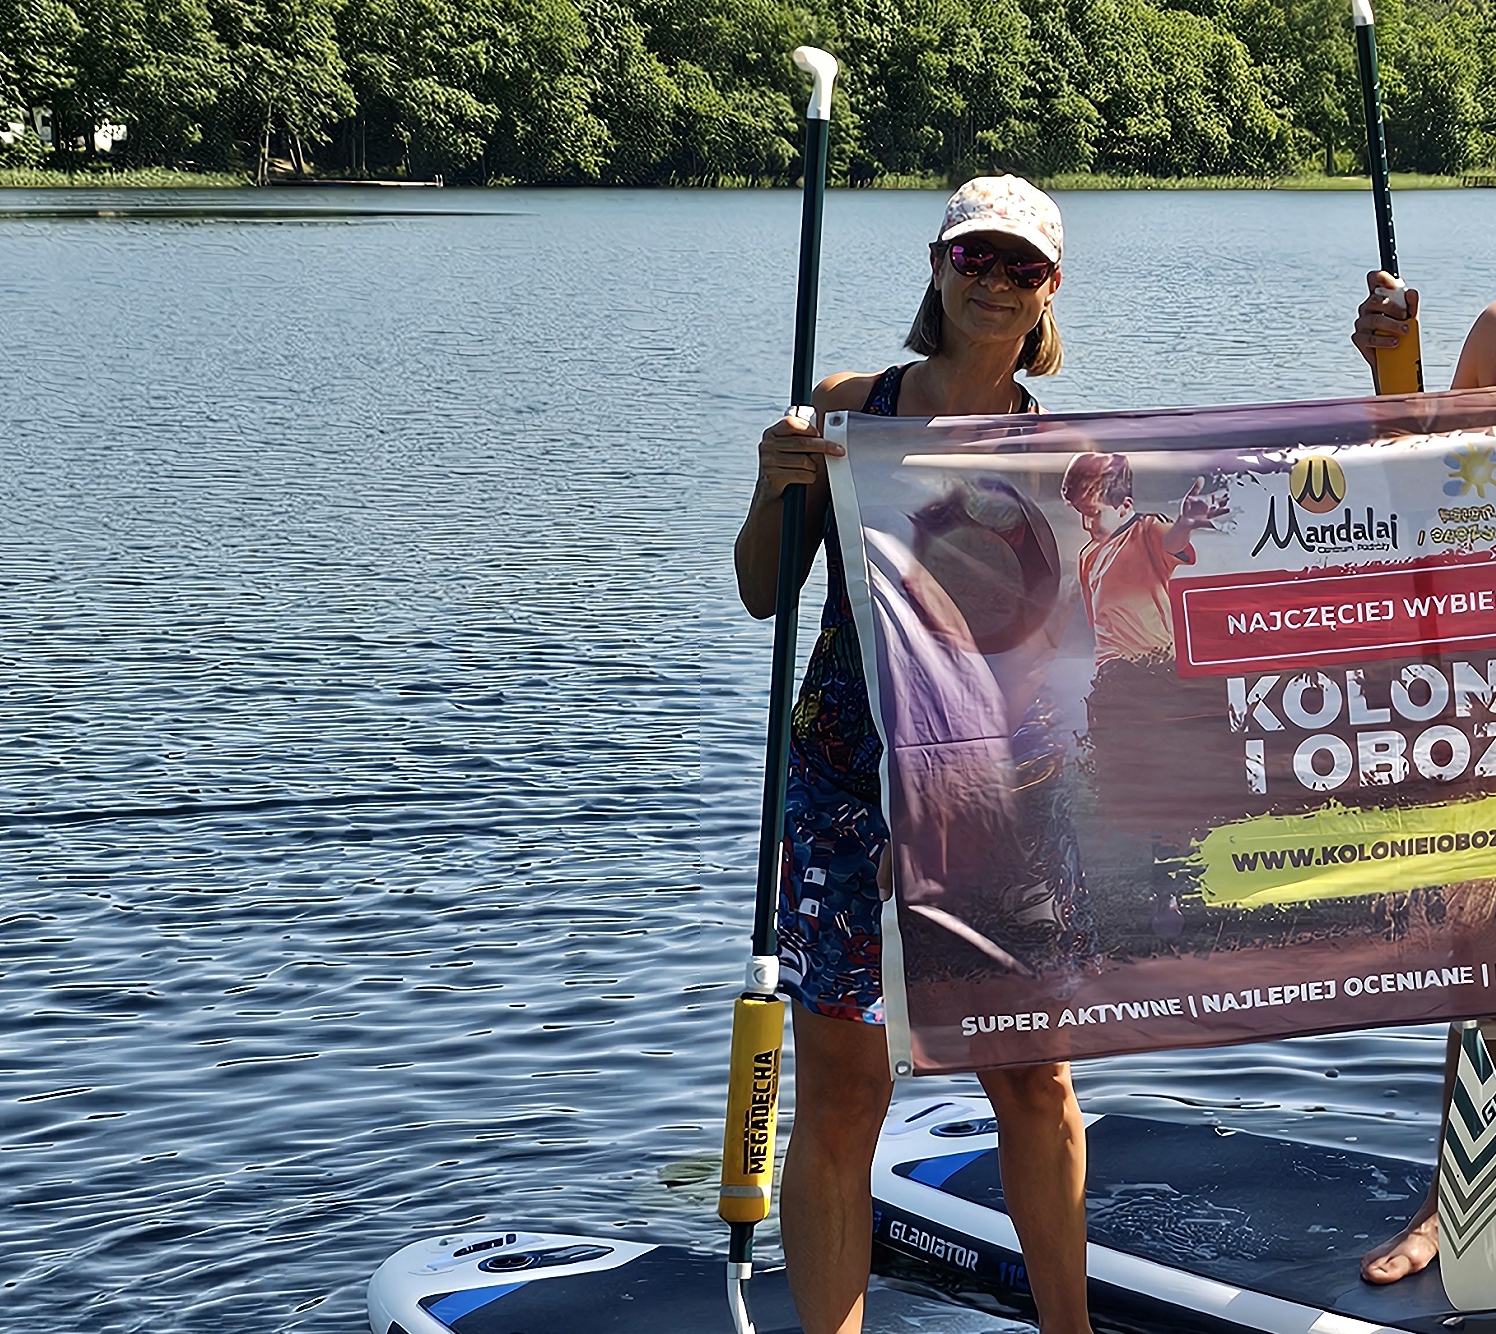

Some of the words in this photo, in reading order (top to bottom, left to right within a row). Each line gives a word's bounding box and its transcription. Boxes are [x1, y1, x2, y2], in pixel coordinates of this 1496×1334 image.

[1251, 495, 1398, 556] Mandalaj
[1227, 599, 1395, 637] NAJCZĘCIEJ
[1245, 738, 1268, 795] I
[961, 1011, 1050, 1038] SUPER
[1056, 998, 1185, 1029] AKTYWNE
[1202, 980, 1337, 1014] NAJLEPIEJ
[1343, 966, 1475, 998] OCENIANE
[747, 1049, 774, 1175] MEGADECHA
